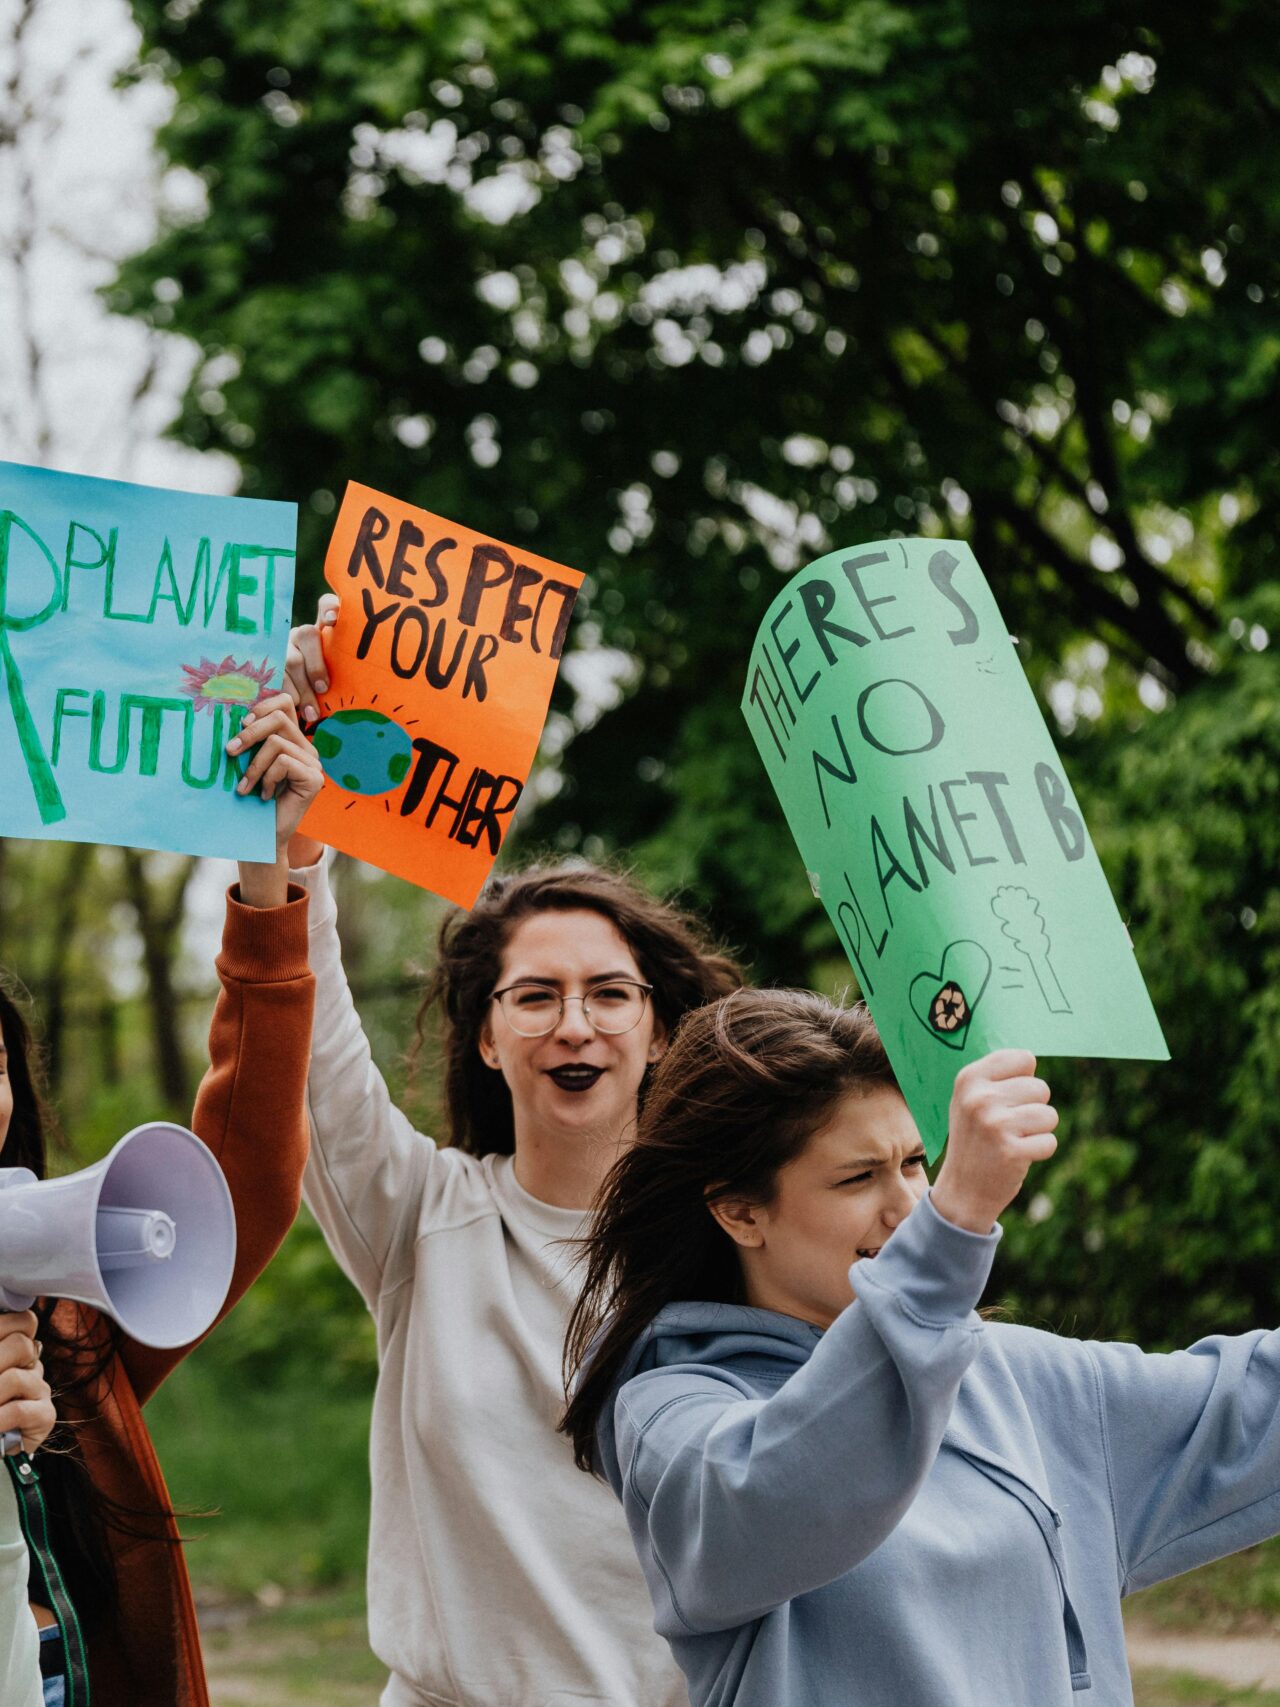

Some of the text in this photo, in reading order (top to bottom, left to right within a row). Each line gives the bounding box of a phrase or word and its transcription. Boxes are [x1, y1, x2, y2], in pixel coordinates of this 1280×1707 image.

[61, 520, 297, 638] PLANET
[347, 506, 580, 660] RESPECT
[356, 588, 499, 702] YOUR
[748, 542, 980, 763] THERE'S
[51, 688, 272, 797] FUTUR
[811, 678, 945, 829] NO
[838, 761, 1086, 996] PLANET B
